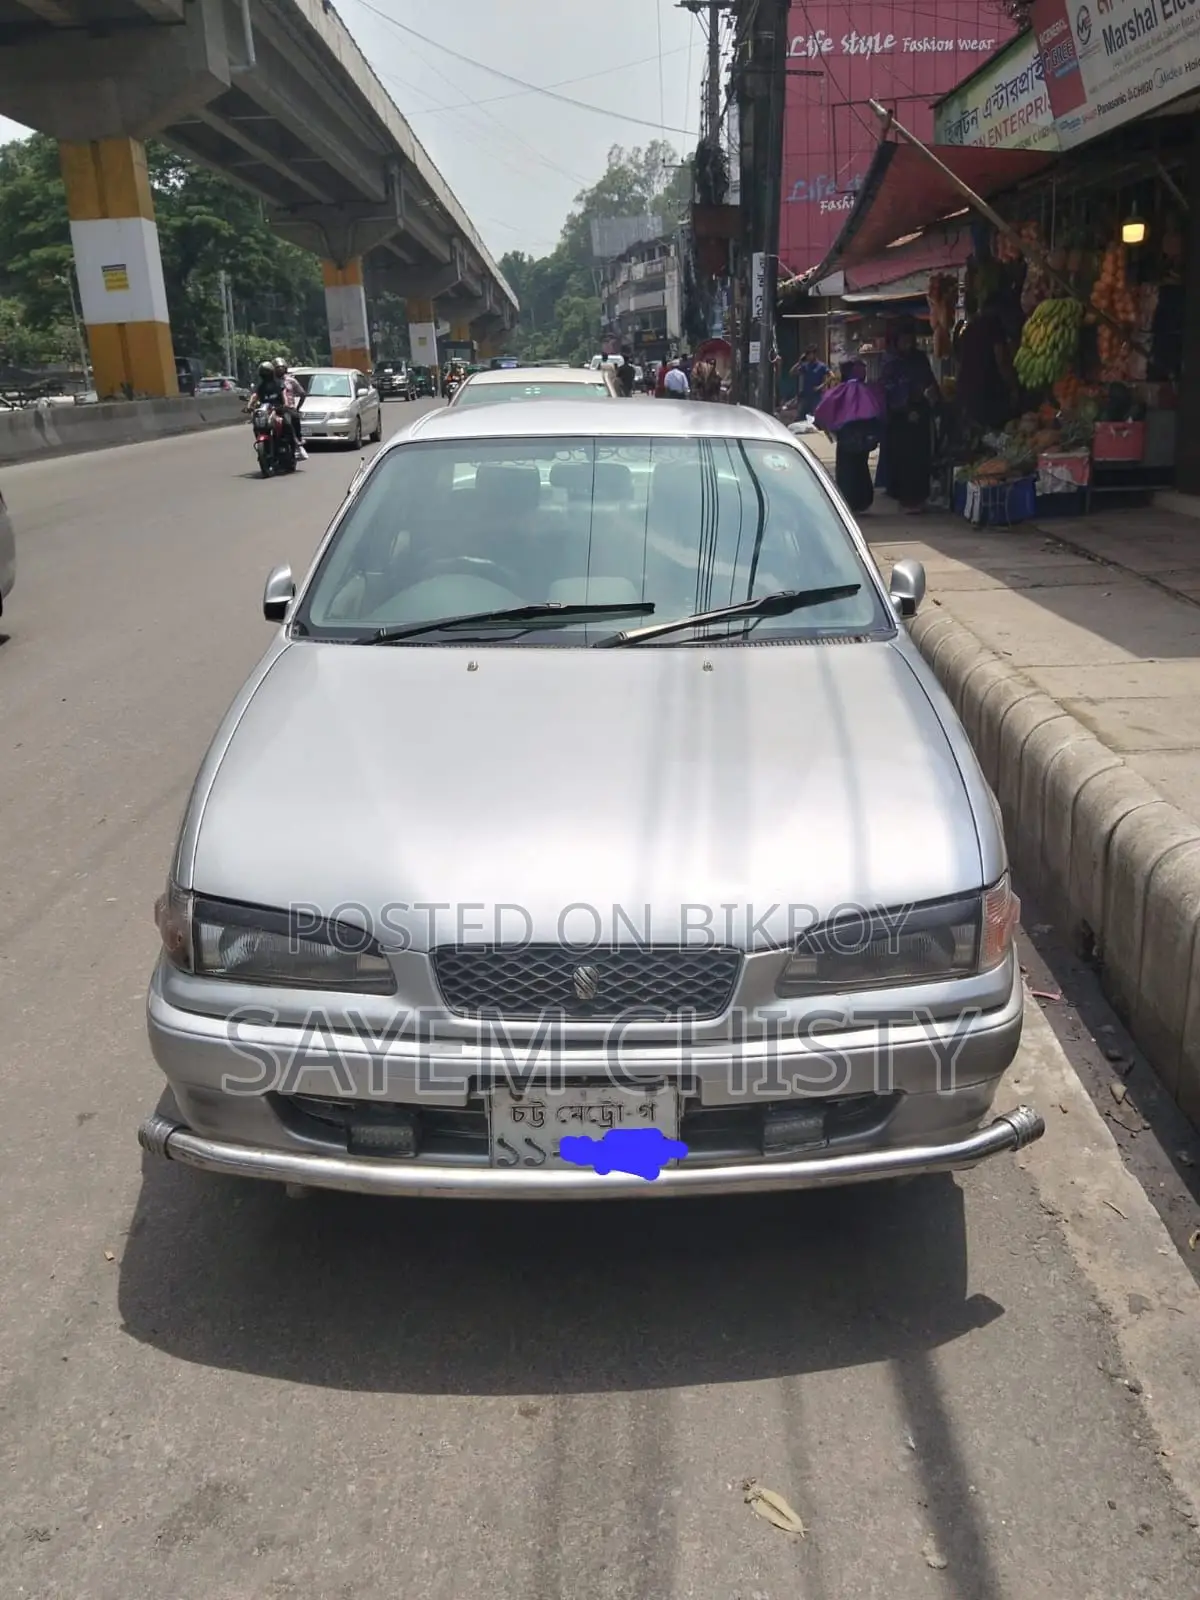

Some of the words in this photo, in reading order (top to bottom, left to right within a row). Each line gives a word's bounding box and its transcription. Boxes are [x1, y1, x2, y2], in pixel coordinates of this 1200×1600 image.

[1102, 0, 1159, 57] Marshal
[786, 30, 834, 60] Life
[840, 30, 897, 60] style
[902, 36, 954, 54] Fashion
[957, 36, 995, 51] wear
[1096, 91, 1127, 116] Panasonic
[785, 175, 836, 203] Life
[820, 195, 856, 216] Fashi
